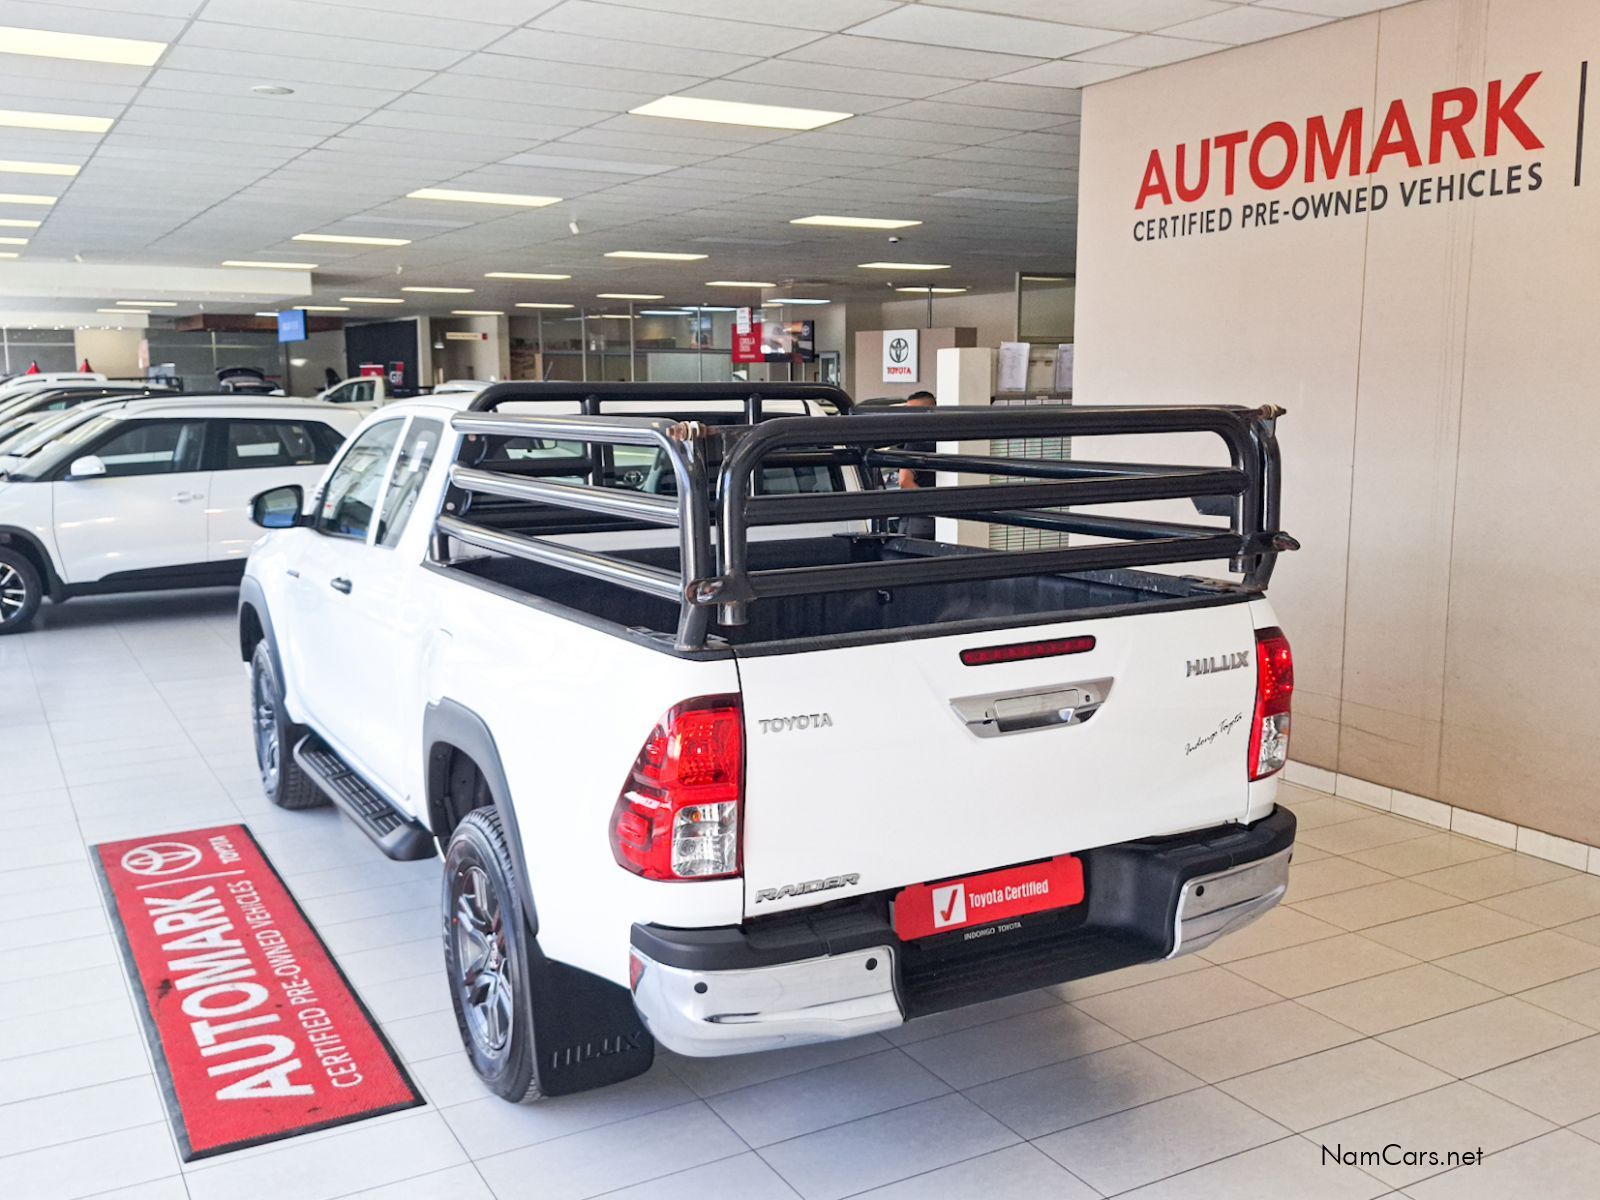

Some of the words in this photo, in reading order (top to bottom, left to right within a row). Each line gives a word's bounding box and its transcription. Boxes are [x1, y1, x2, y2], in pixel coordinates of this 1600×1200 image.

[1134, 71, 1545, 210] AUTOMARK
[1133, 207, 1232, 242] CERTIFIED
[1241, 184, 1389, 229] PRE-OWNED
[1399, 162, 1543, 207] VEHICLES
[887, 366, 912, 375] TOYOTA
[1186, 650, 1249, 677] HILUX
[758, 712, 833, 735] TOYOTA
[208, 835, 242, 865] TOYOTA
[227, 880, 275, 928] VEHICLES
[755, 872, 860, 904] RAIDER
[968, 888, 1004, 910] Toyota
[1005, 879, 1049, 902] Certified
[964, 926, 996, 941] INDONGO
[998, 921, 1022, 933] TOYOTA
[255, 929, 318, 1006] PRE-OWNED
[143, 885, 316, 1102] AUTOMARK
[298, 1005, 363, 1089] CERTIFIED
